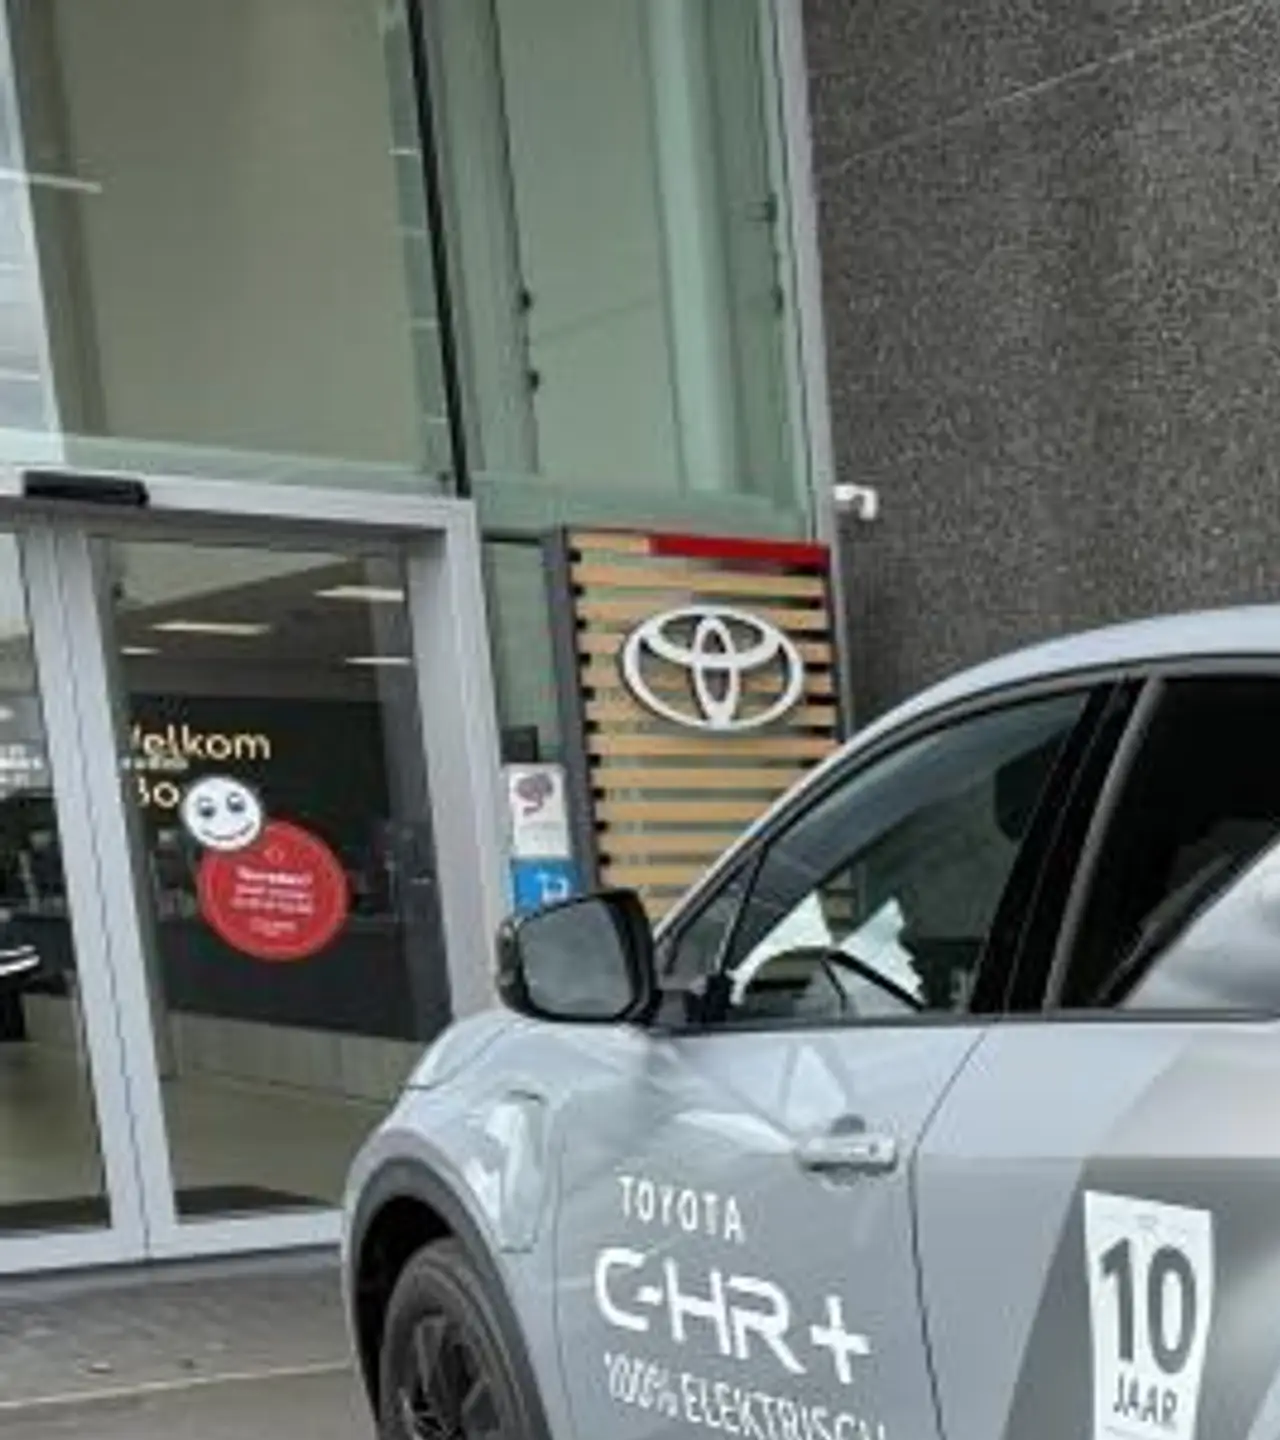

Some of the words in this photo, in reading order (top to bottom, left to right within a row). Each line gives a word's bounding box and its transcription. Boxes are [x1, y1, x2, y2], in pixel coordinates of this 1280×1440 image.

[617, 1175, 745, 1243] TOYOTA
[1100, 1236, 1197, 1375] 10
[1112, 1372, 1178, 1432] JAAR
